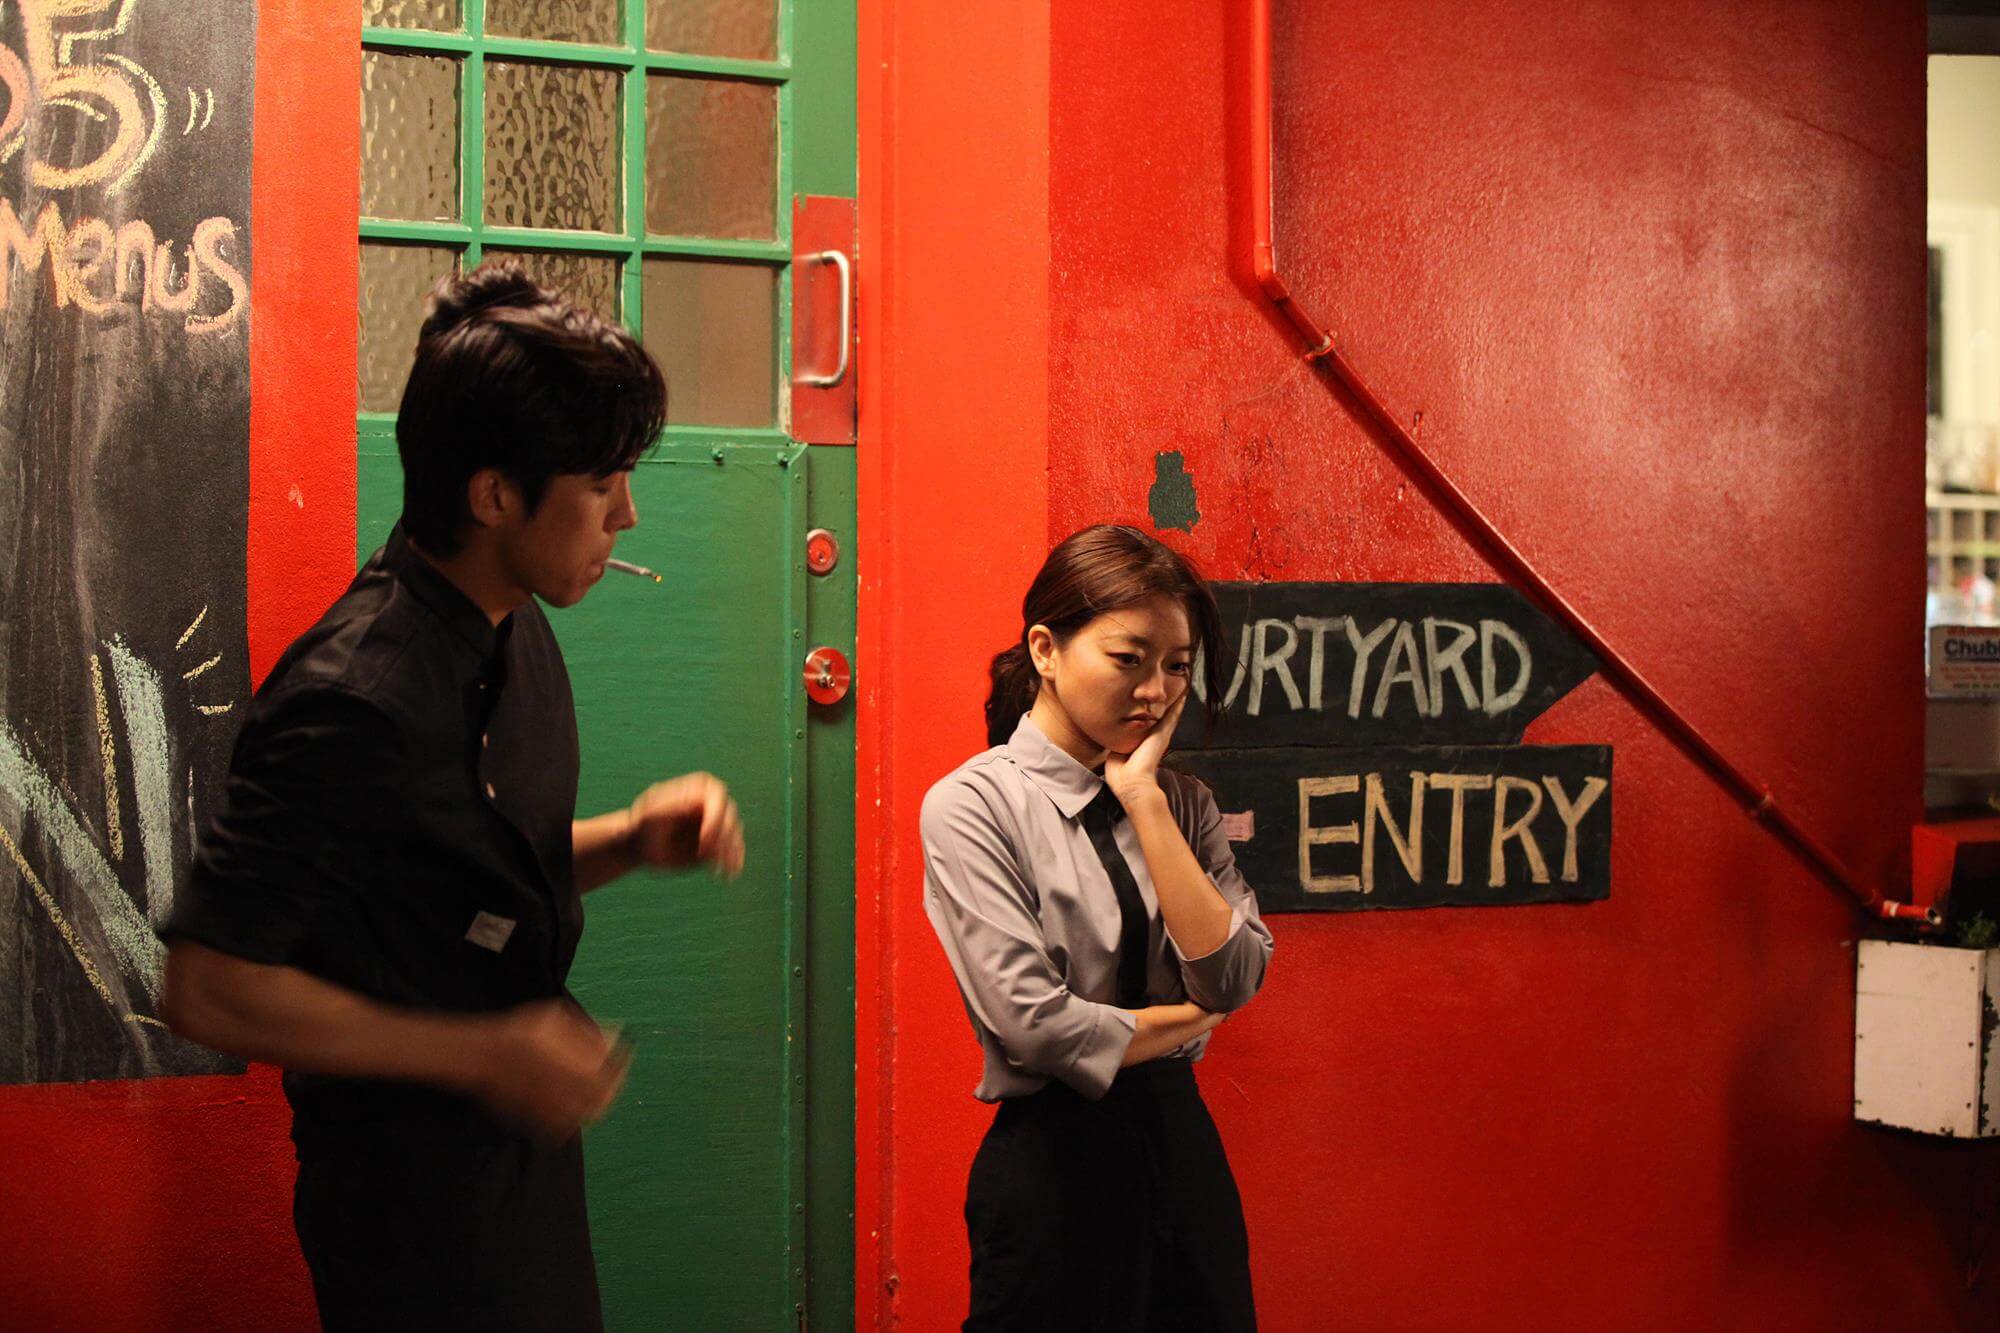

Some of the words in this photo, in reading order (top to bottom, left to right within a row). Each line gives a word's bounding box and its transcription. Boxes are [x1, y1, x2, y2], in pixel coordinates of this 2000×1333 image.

[0, 197, 247, 333] Menus
[1192, 614, 1532, 718] URTYARD
[1298, 771, 1608, 894] ENTRY
